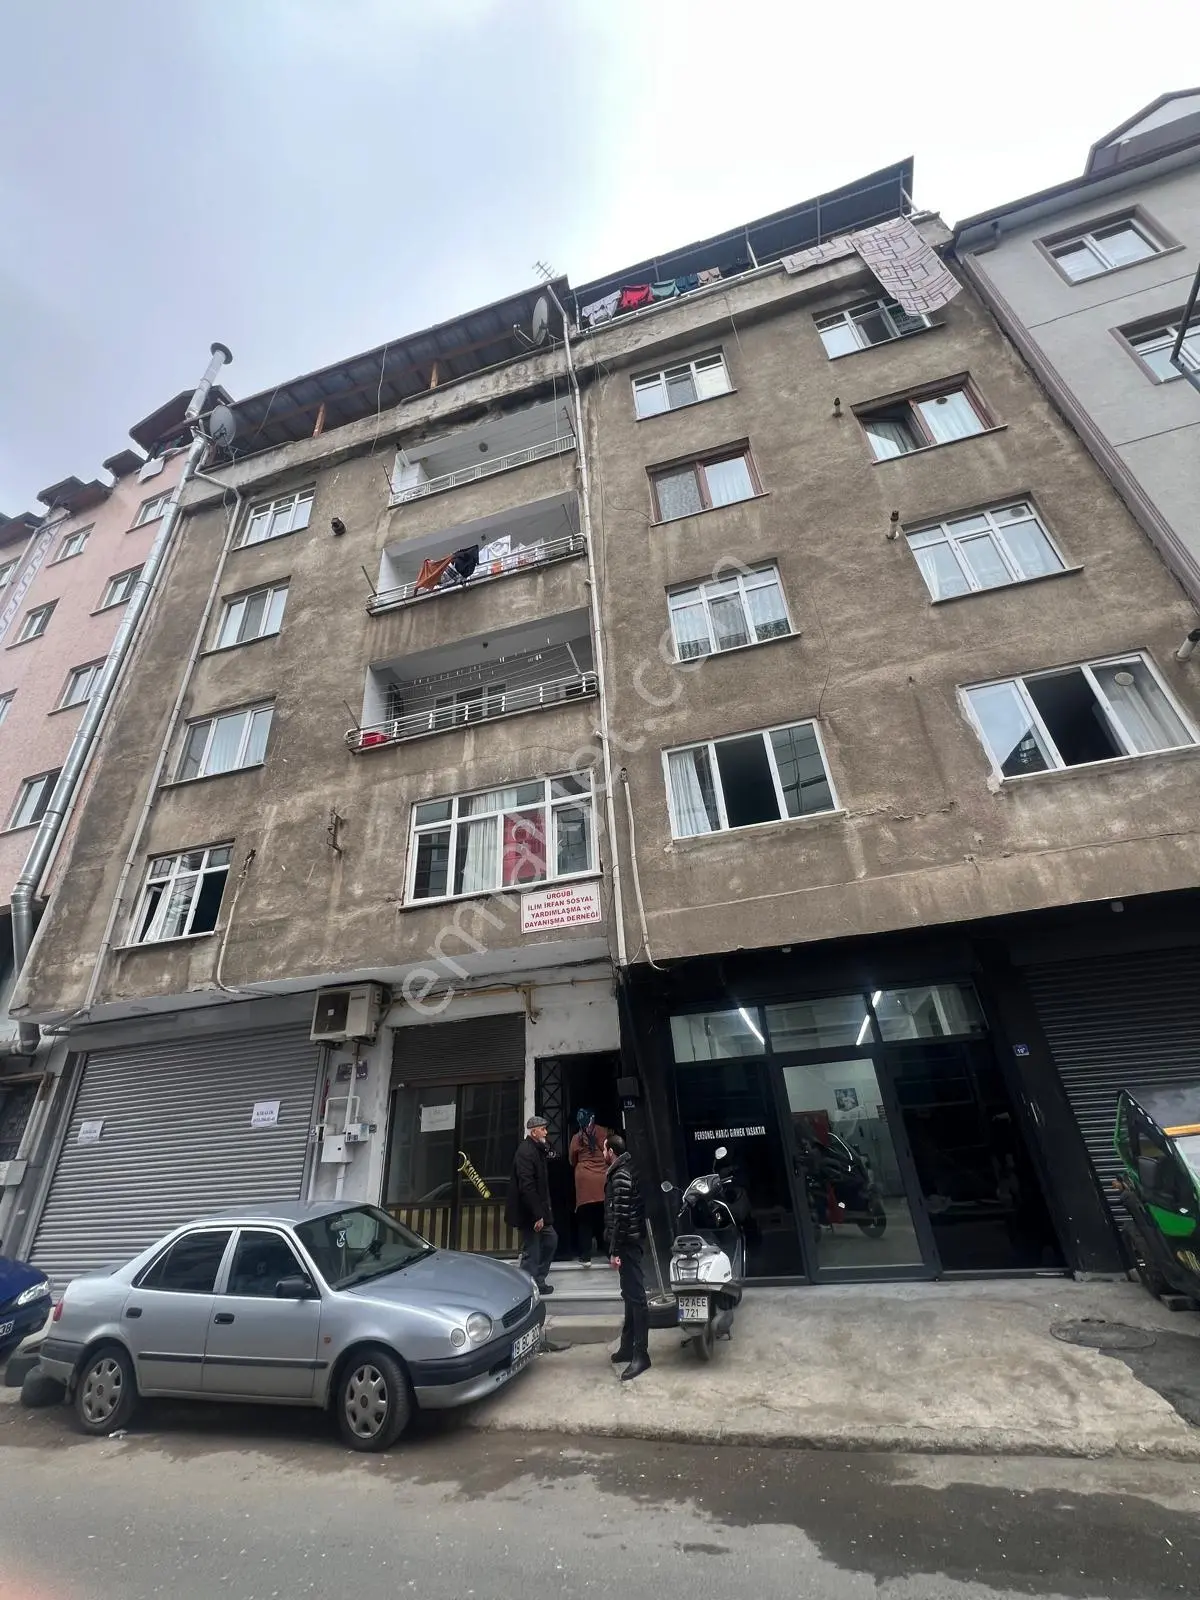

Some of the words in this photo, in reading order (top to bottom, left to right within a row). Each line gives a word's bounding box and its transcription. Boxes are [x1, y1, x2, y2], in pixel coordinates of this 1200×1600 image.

[544, 900, 565, 909] İRFAN
[566, 895, 594, 905] SOSYAL
[531, 905, 581, 919] YARDIMLAŞMA
[524, 917, 565, 929] DAYANIŞMA
[694, 1130, 715, 1141] PERSONEL
[679, 1298, 689, 1307] 52
[690, 1298, 707, 1307] AEE
[685, 1308, 699, 1318] 721
